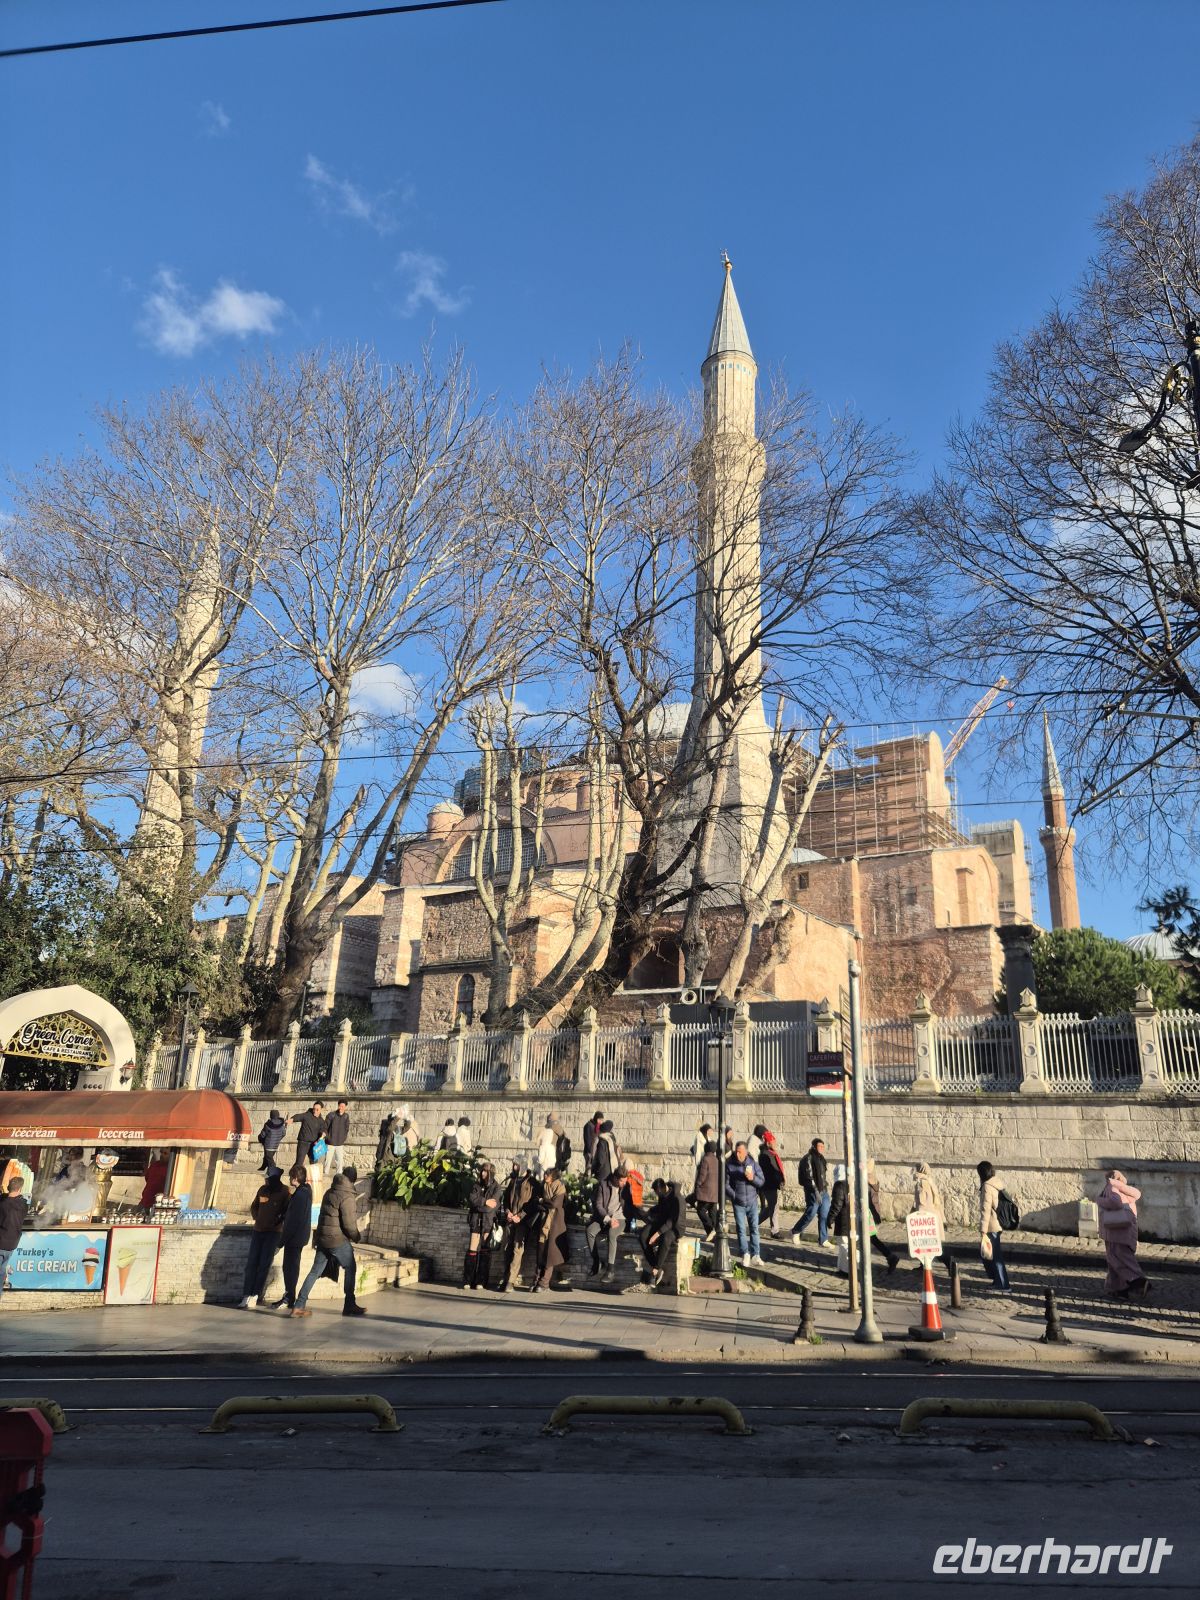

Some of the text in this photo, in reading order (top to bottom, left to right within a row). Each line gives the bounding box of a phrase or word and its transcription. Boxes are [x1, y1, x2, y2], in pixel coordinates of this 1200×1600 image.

[21, 1021, 95, 1046] Green Corner
[60, 1048, 96, 1057] RESTAURANT
[11, 1127, 144, 1139] Icecream Icecream
[910, 1216, 936, 1227] CHANGE
[911, 1228, 937, 1237] OFFICE
[17, 1247, 54, 1258] Turkey's
[16, 1259, 78, 1273] ICE CREAM
